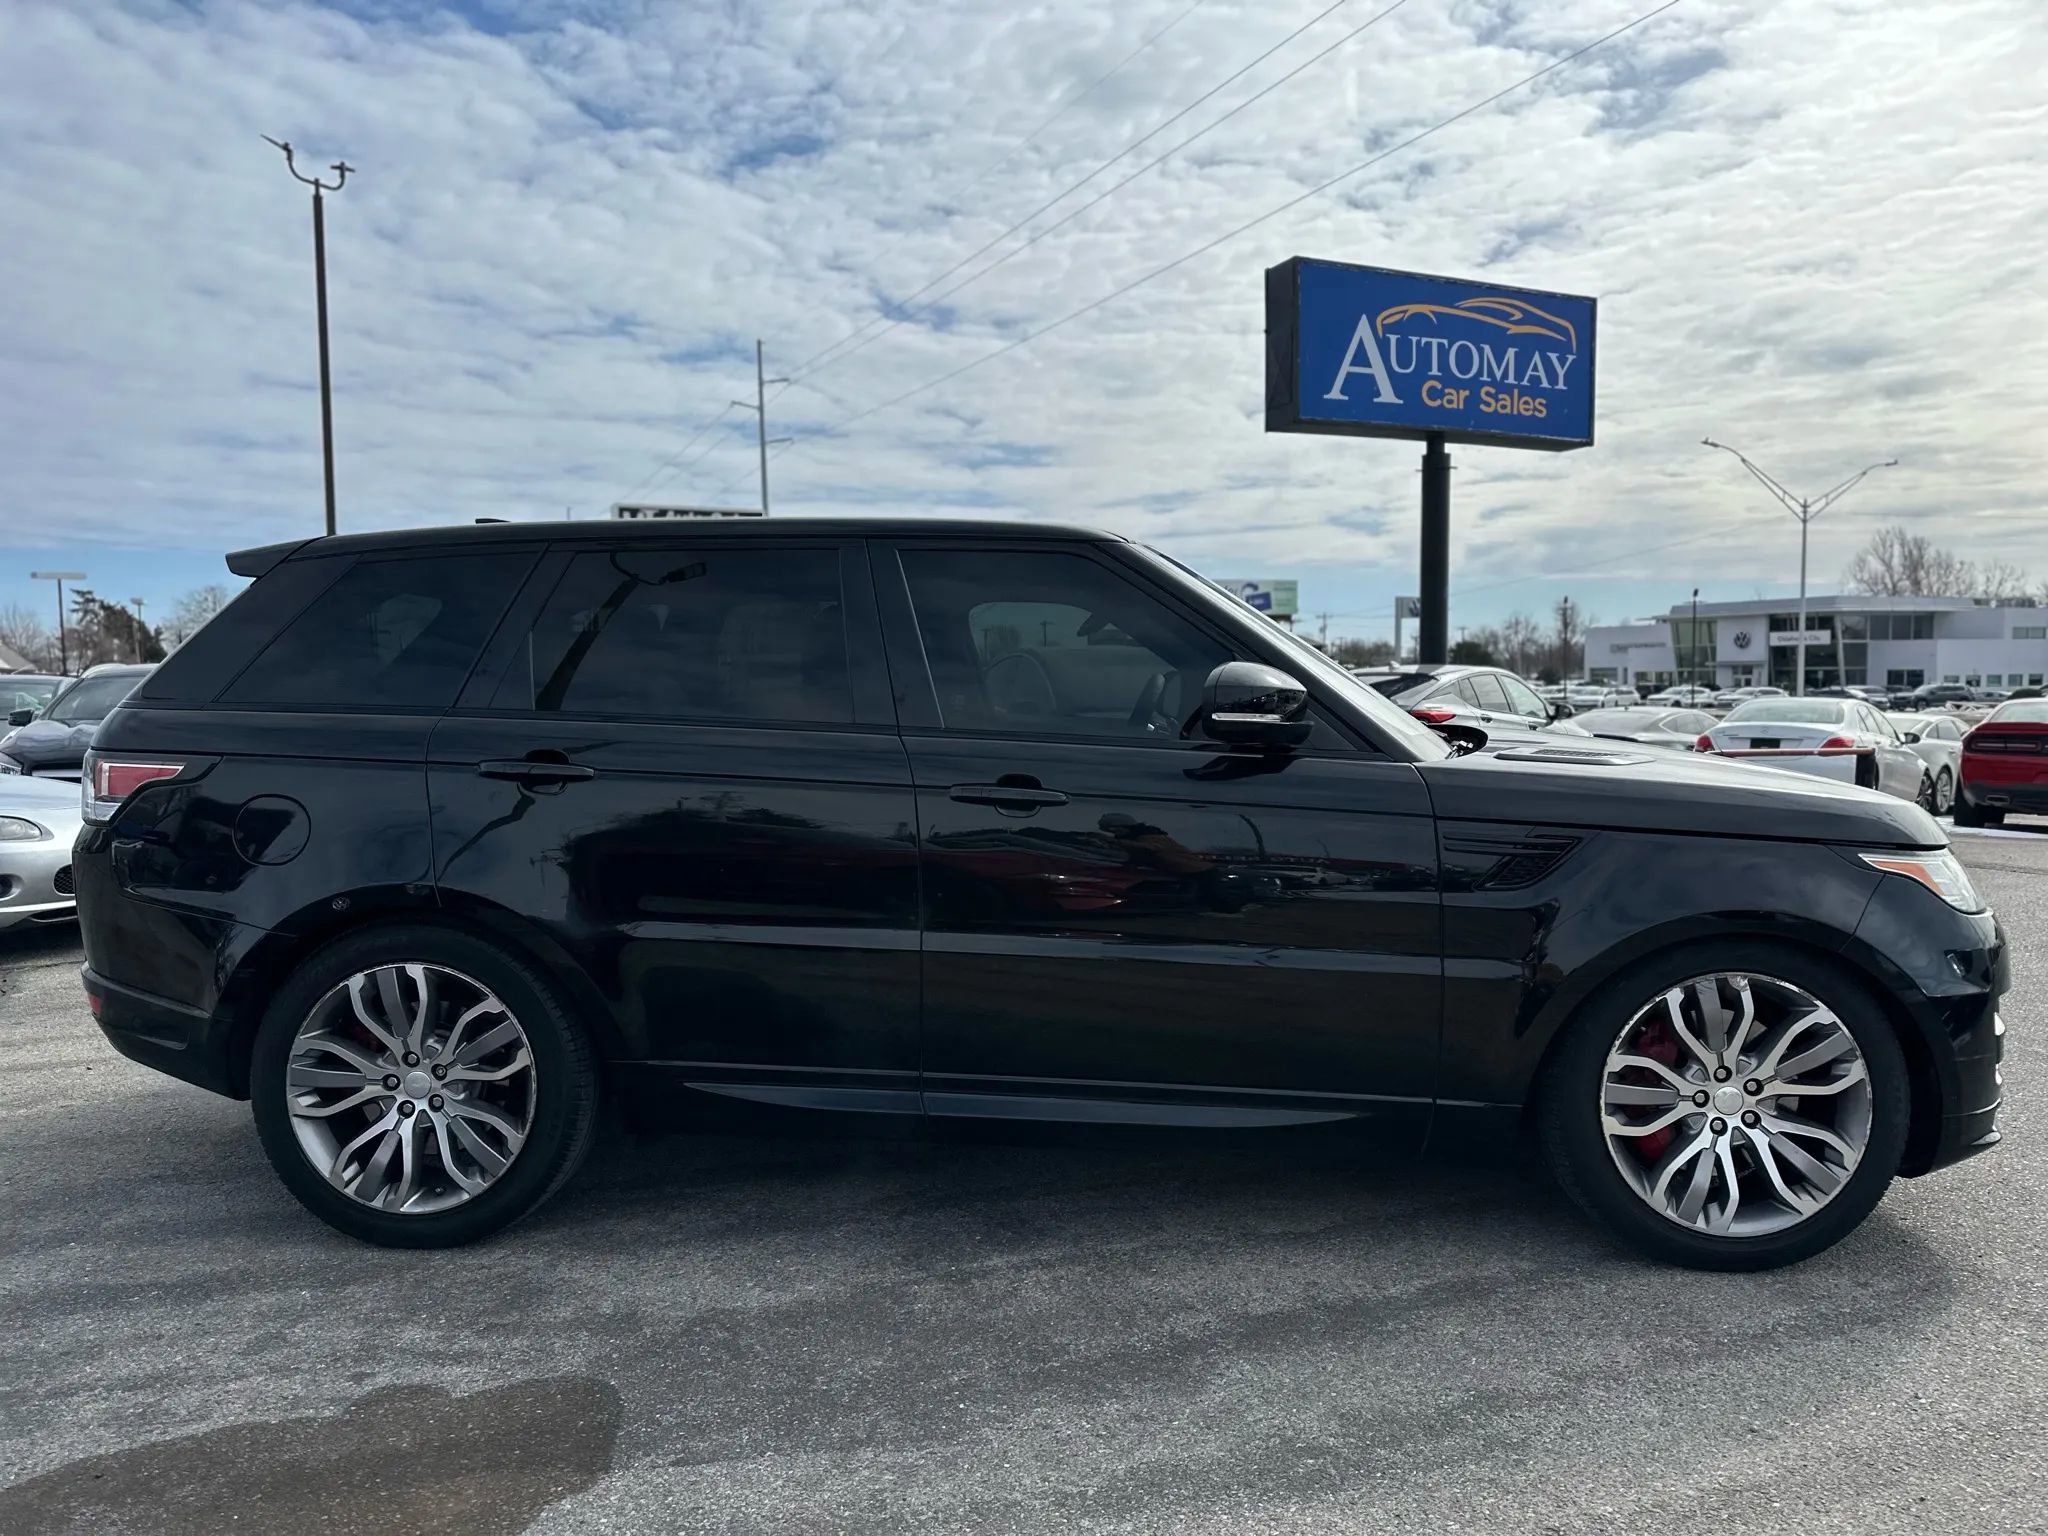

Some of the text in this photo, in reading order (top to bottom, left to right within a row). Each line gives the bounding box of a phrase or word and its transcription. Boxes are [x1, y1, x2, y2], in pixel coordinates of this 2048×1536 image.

[1323, 313, 1577, 404] AUTOMAY
[1421, 379, 1548, 418] Car Sales
